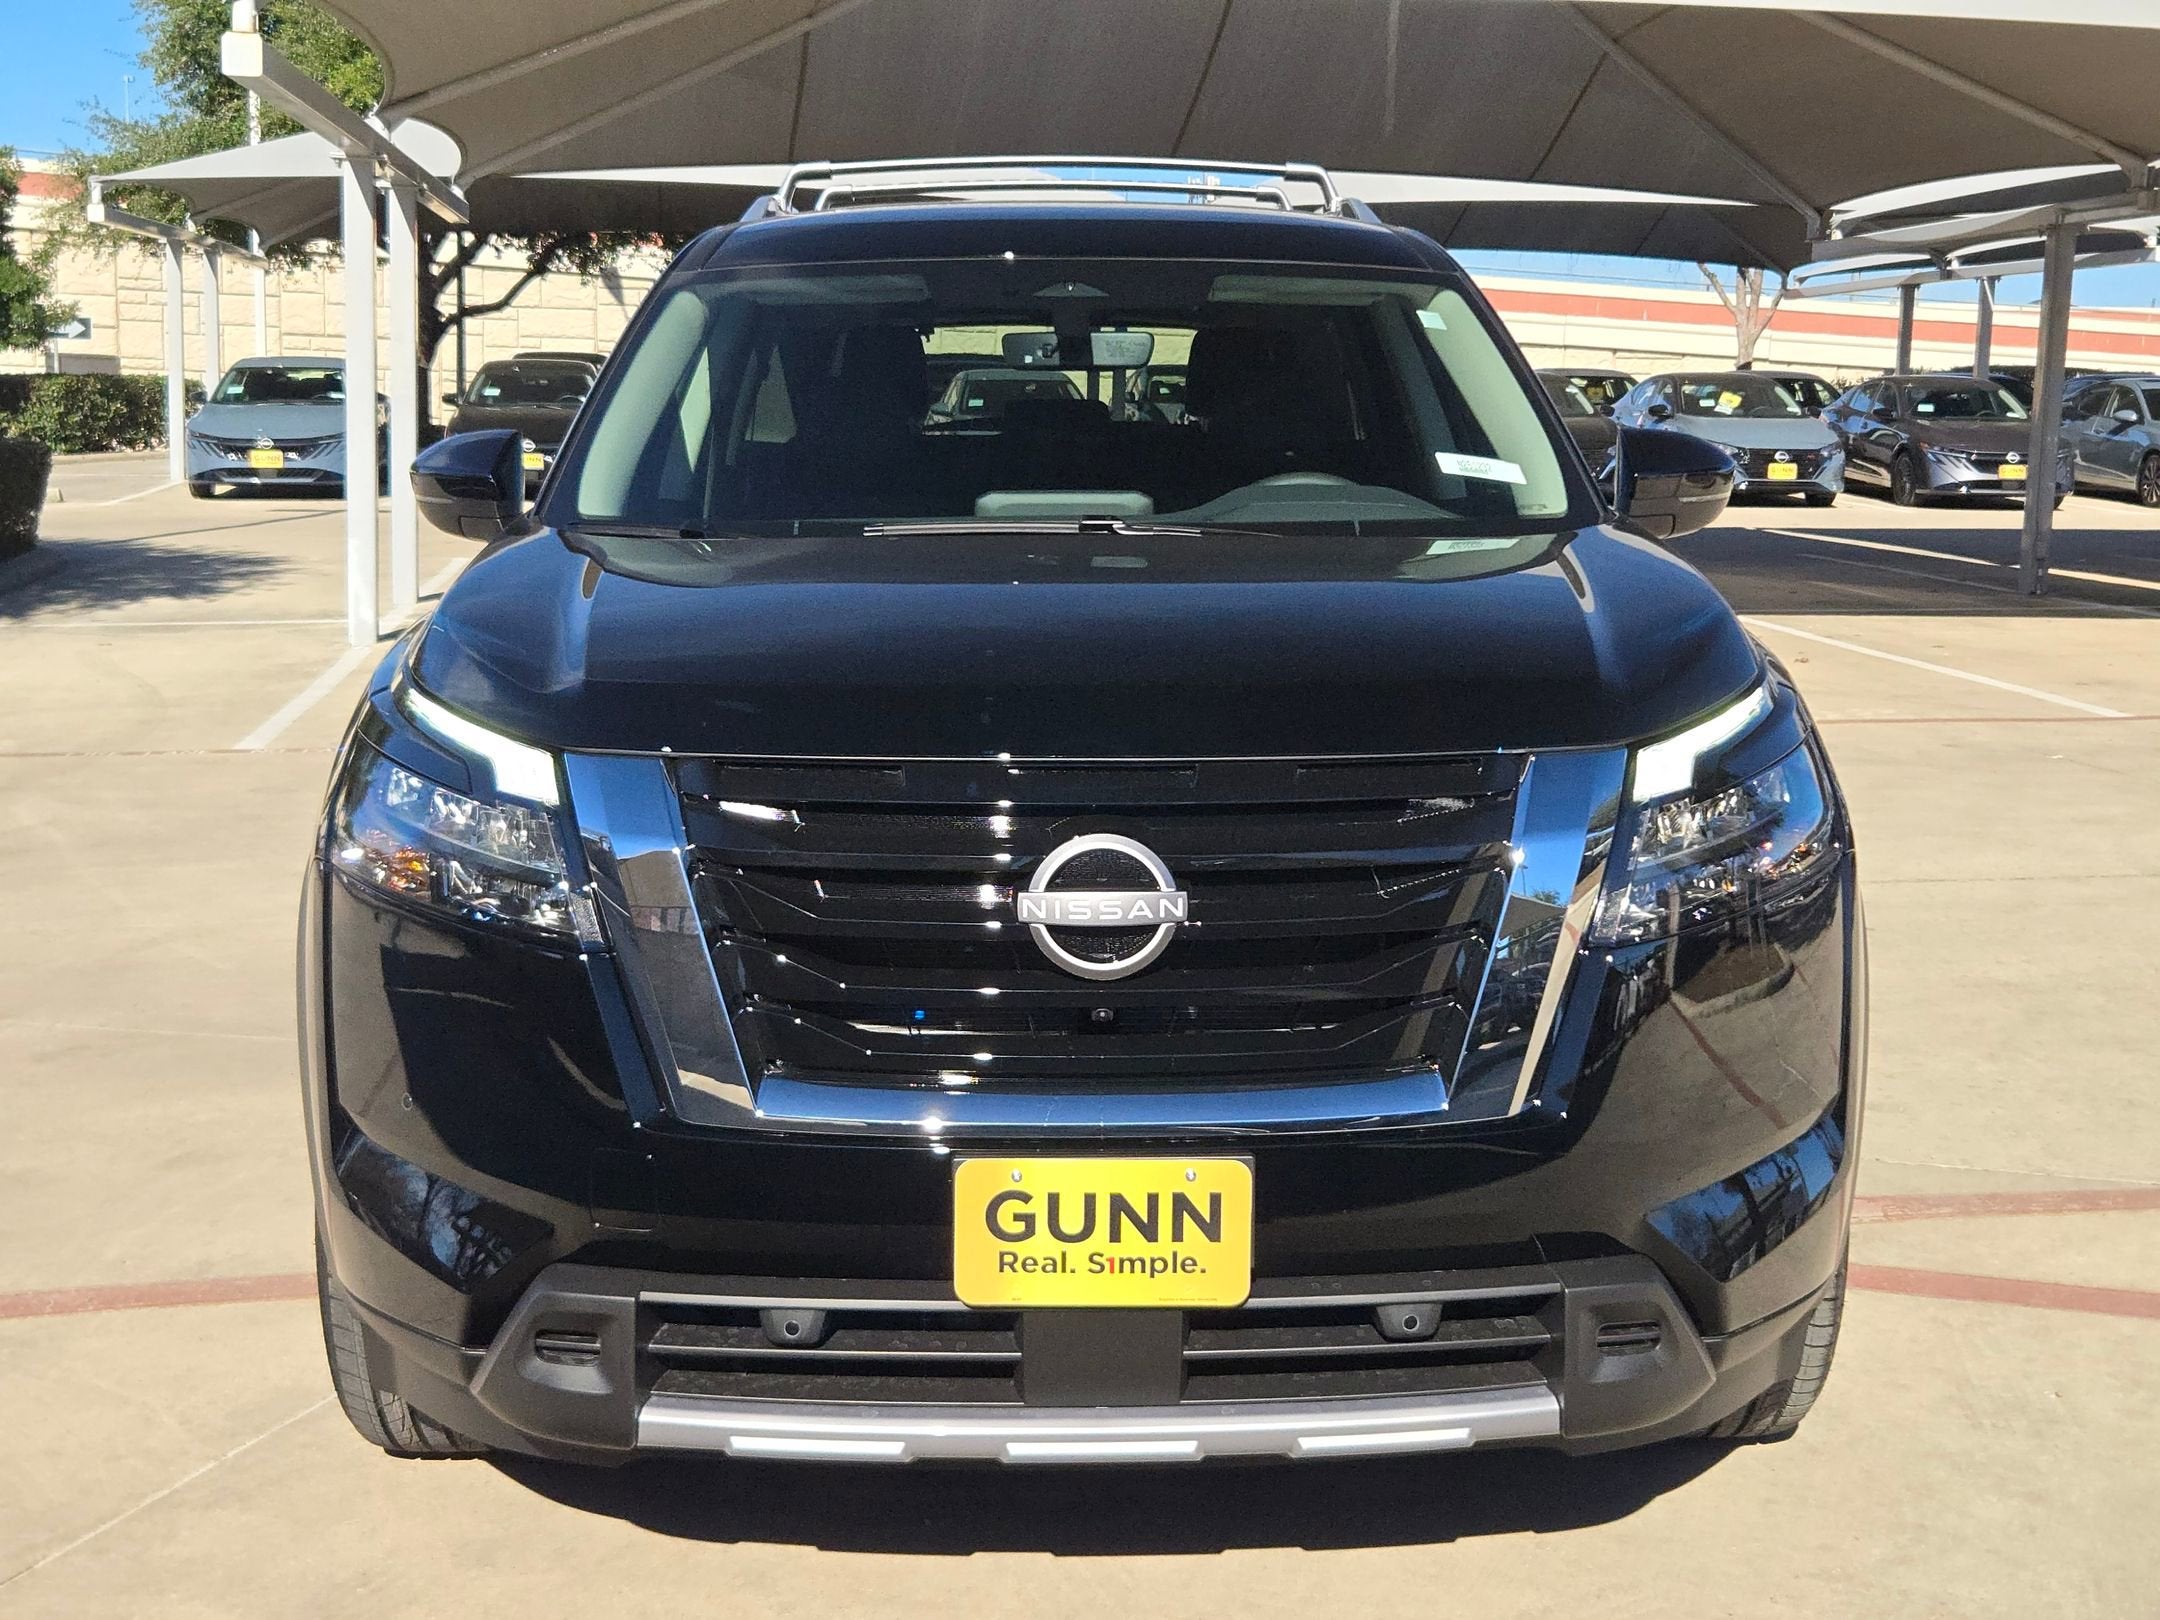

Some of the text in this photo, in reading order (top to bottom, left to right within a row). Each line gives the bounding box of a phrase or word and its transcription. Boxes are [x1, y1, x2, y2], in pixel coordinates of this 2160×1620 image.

[1022, 897, 1183, 920] NISSAN
[984, 1189, 1222, 1243] GUNN
[999, 1250, 1076, 1274] Real.
